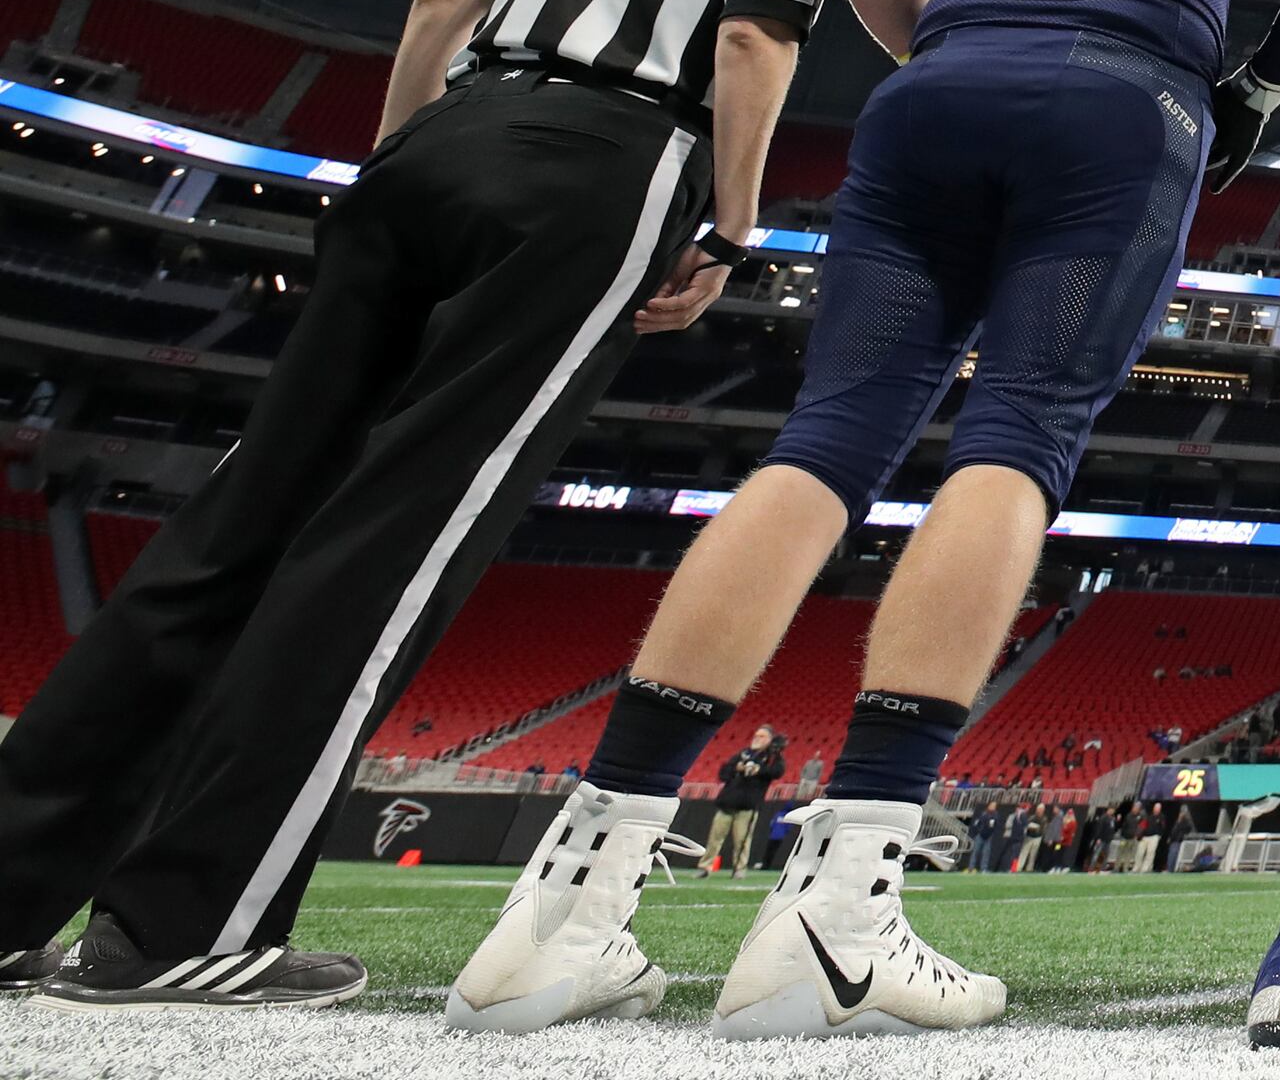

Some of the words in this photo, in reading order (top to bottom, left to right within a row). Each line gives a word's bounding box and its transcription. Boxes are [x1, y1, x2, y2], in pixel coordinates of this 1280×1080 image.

[1157, 90, 1198, 137] FASTER
[559, 483, 631, 509] 10:04
[629, 676, 713, 716] VAPOR
[854, 691, 920, 714] APOR
[1173, 769, 1205, 797] 25
